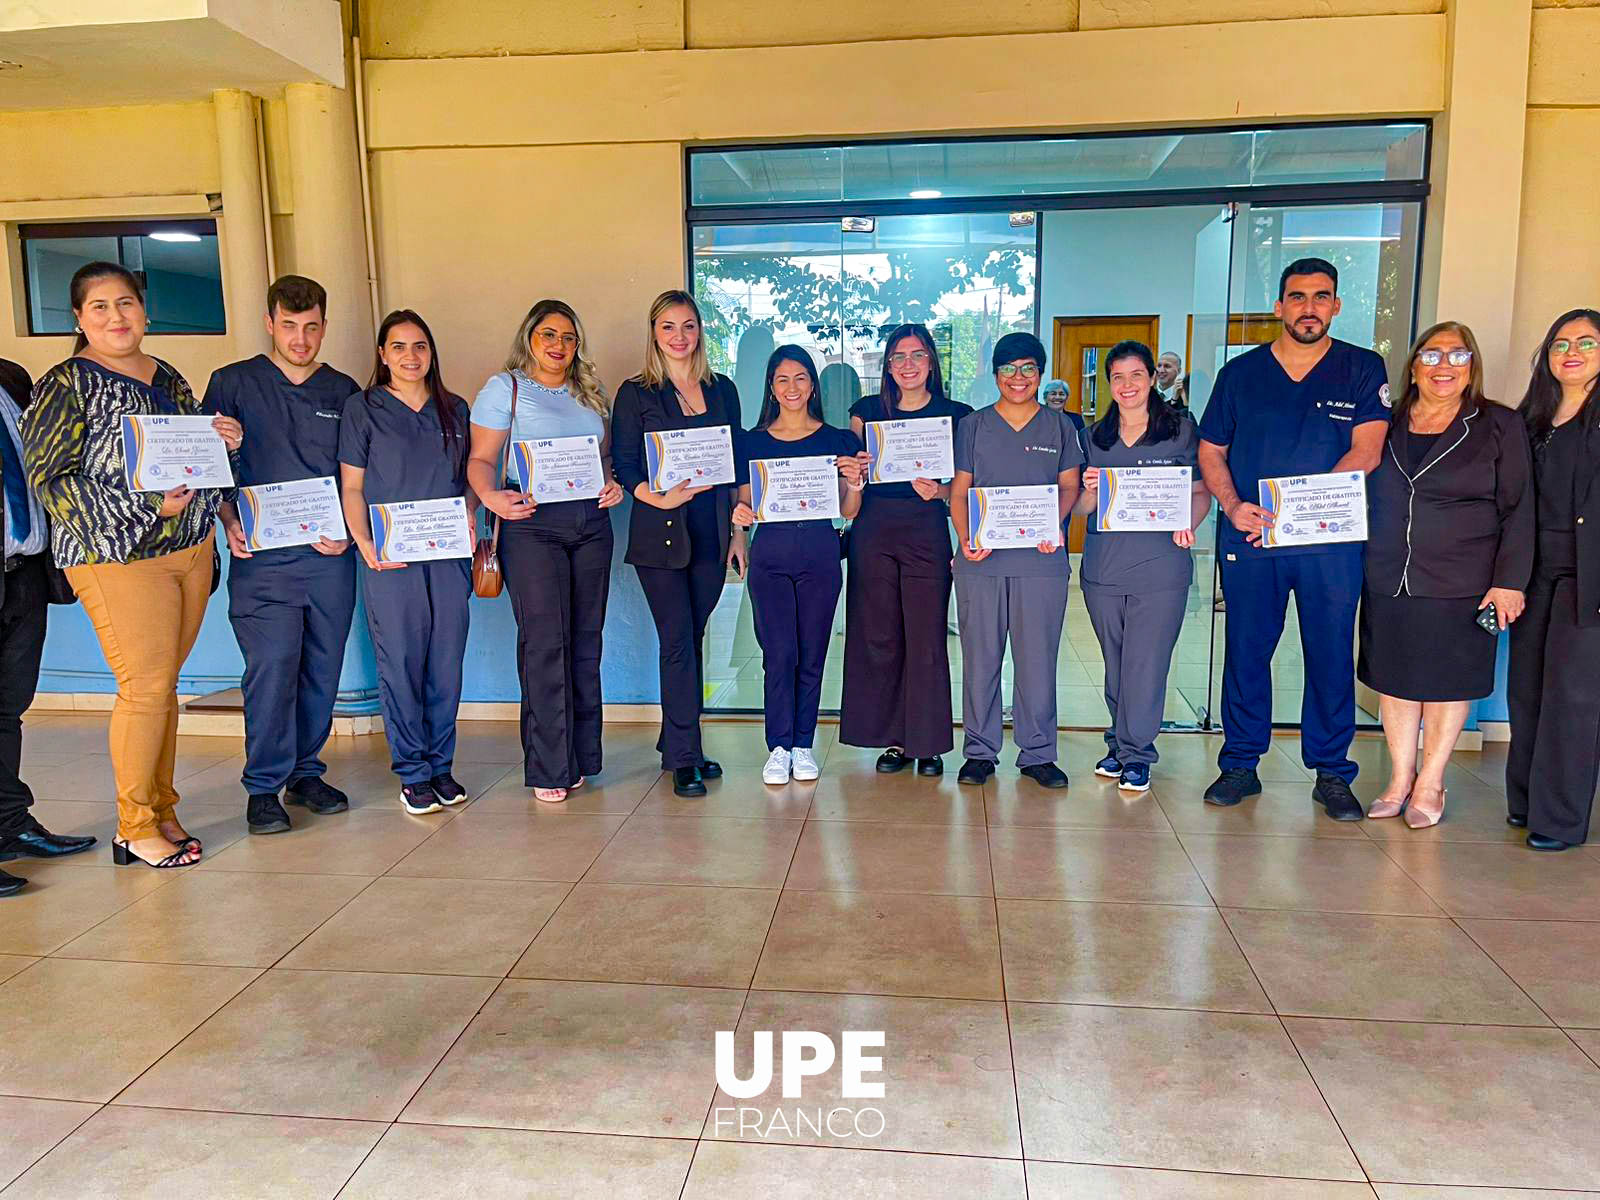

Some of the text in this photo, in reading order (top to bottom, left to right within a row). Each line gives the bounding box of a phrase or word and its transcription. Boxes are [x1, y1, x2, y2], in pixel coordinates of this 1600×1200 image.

[538, 440, 553, 448] UPE
[1289, 478, 1308, 486] UPE
[265, 485, 283, 493] UPE
[1283, 495, 1322, 503] CERTIFICADO
[1331, 491, 1362, 499] GRATITUD
